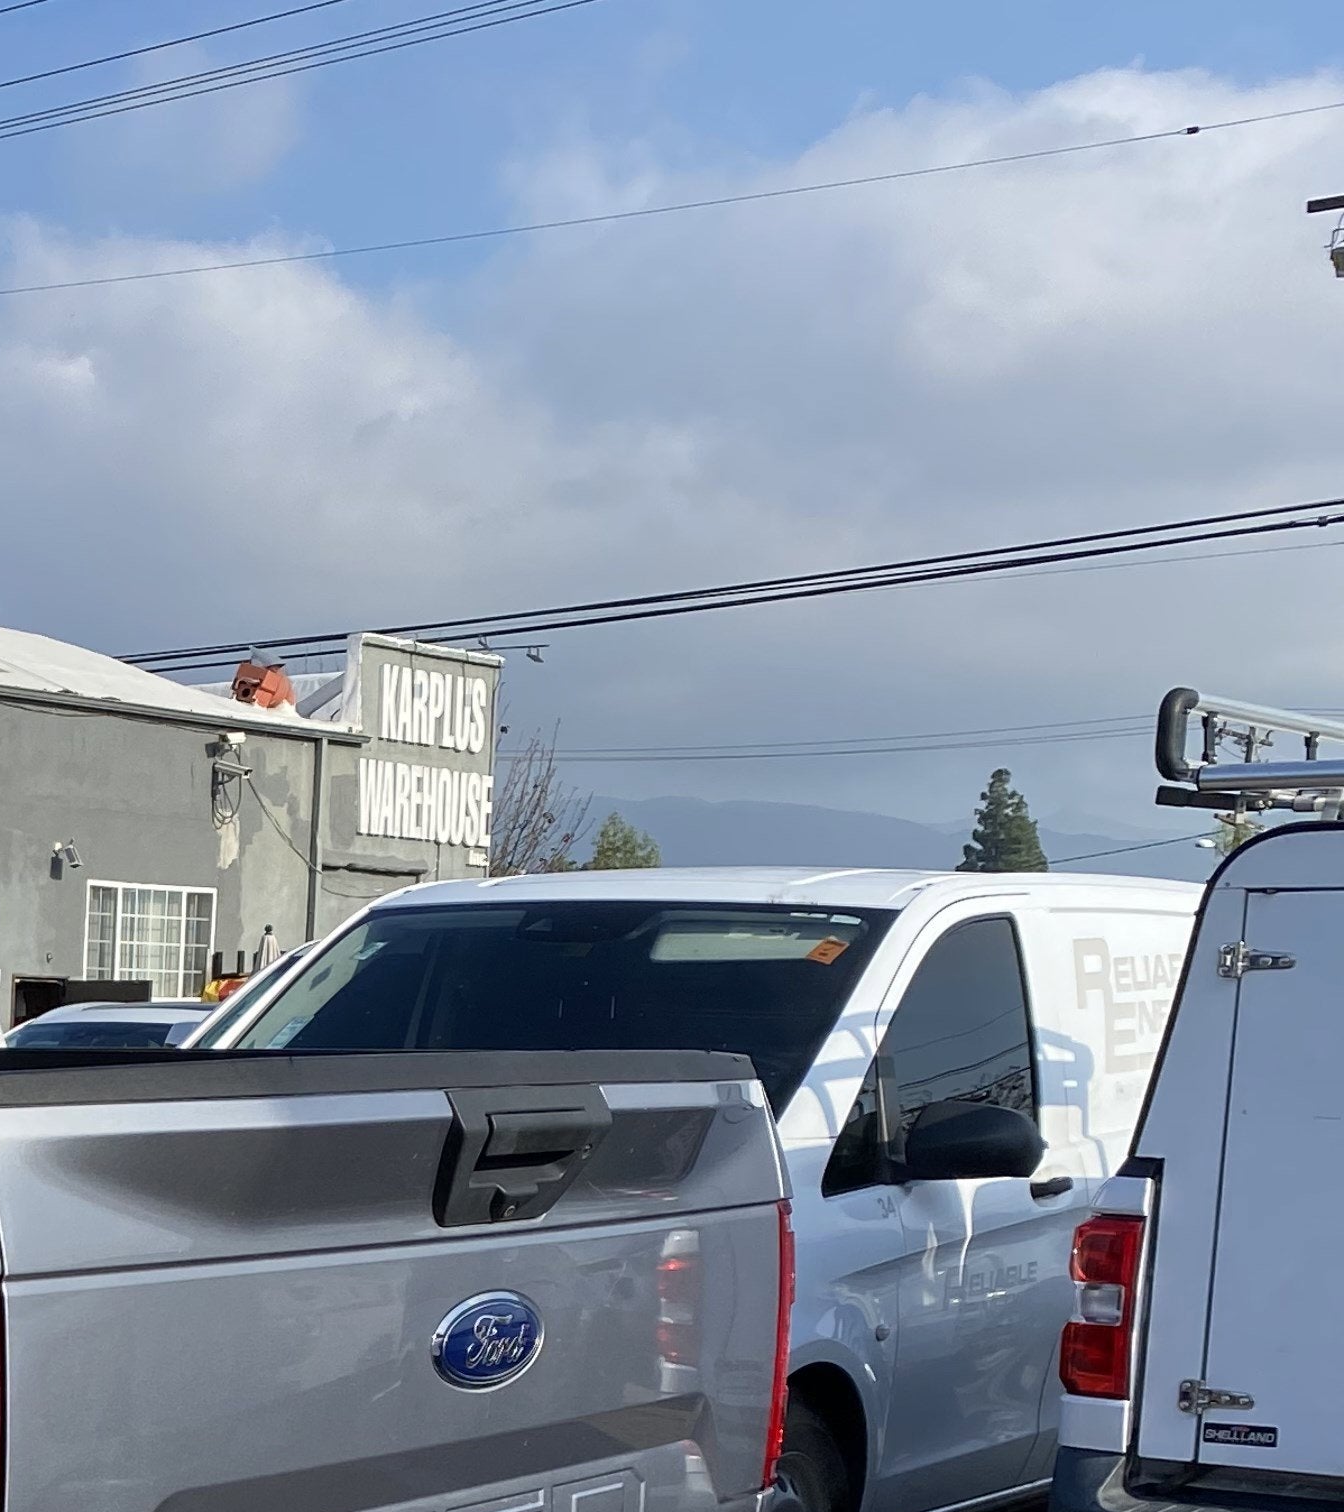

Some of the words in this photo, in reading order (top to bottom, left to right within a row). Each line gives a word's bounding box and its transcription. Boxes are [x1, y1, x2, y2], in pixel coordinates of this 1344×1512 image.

[381, 663, 487, 753] KARPLUS
[358, 757, 494, 848] WAREHOUSE
[877, 1196, 897, 1219] 34
